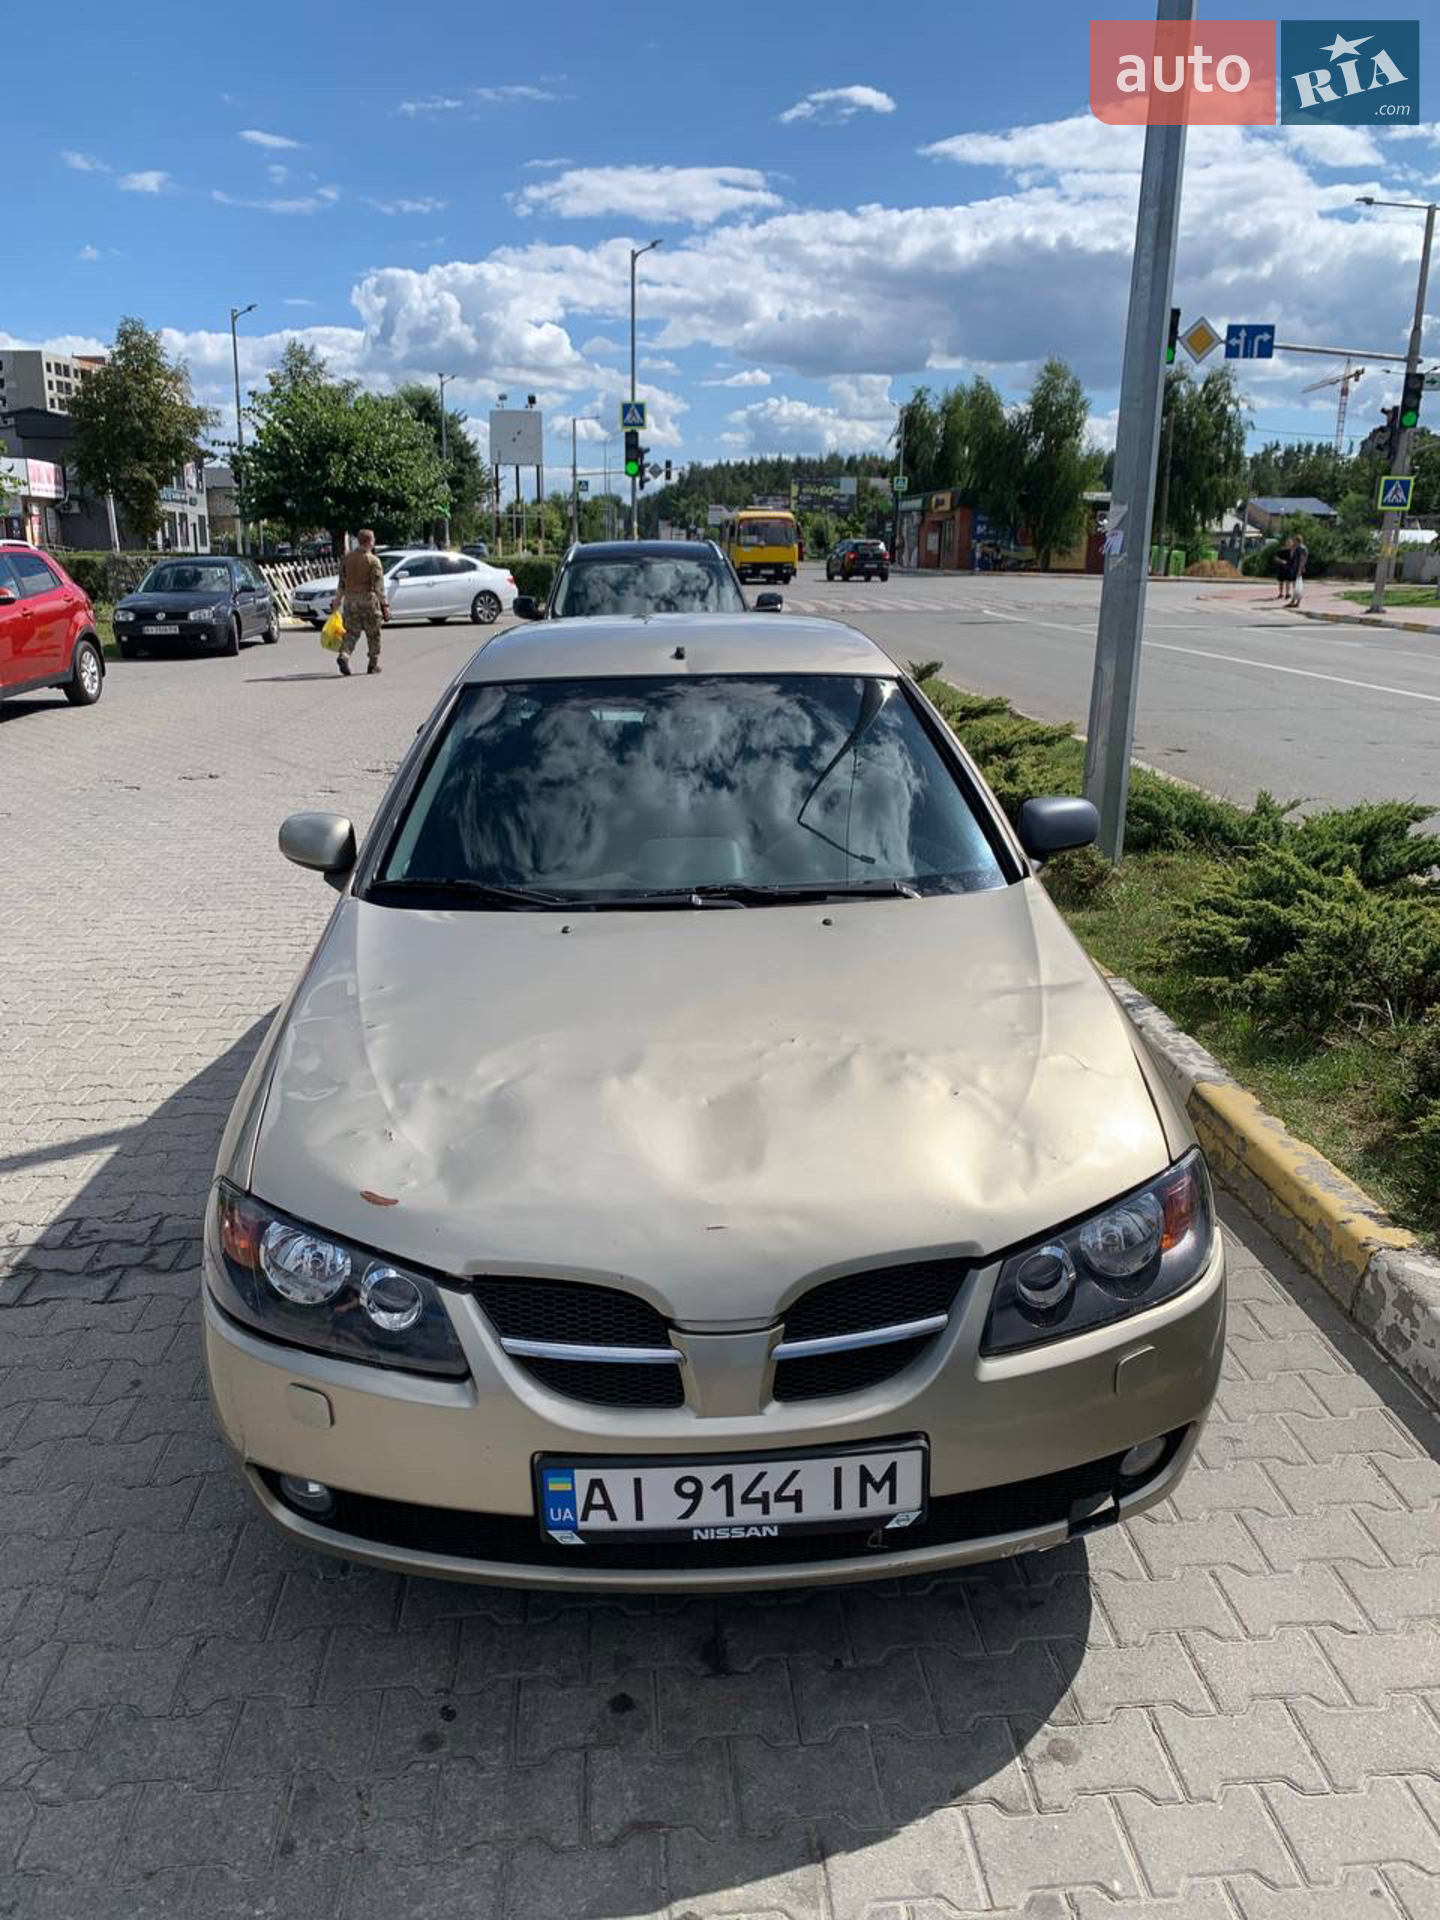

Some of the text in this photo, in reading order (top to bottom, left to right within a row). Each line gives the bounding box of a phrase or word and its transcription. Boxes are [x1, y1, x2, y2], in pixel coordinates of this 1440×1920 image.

[580, 1460, 898, 1522] AI 9144 IM
[549, 1507, 575, 1522] UA
[692, 1525, 779, 1541] NISSAN
